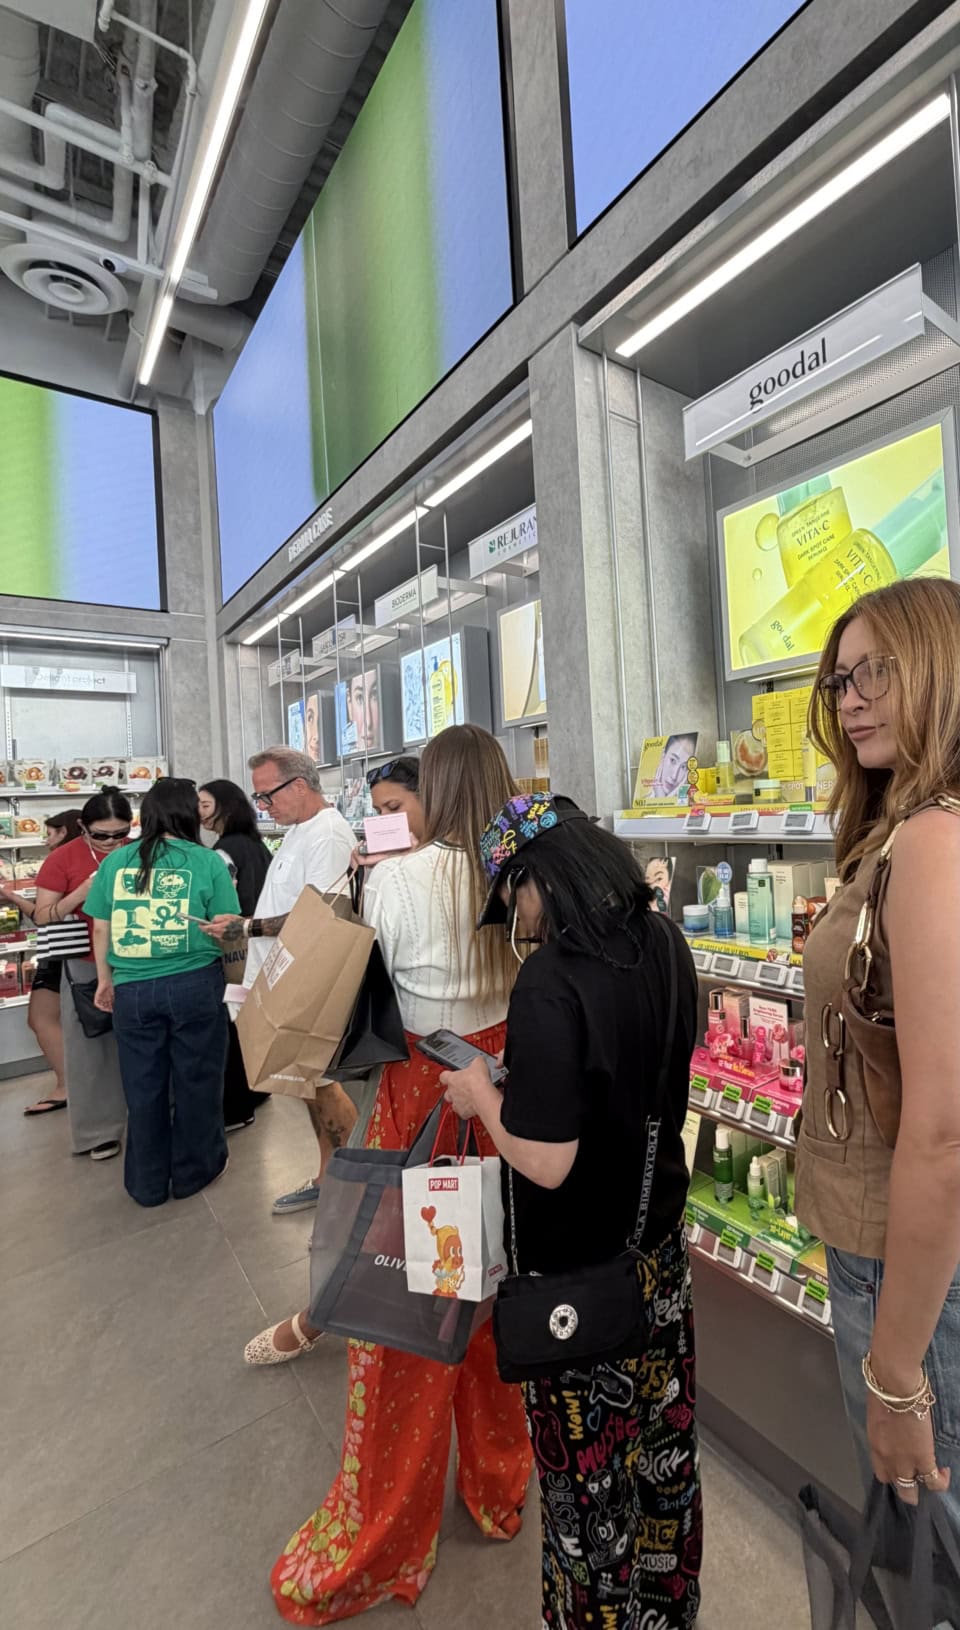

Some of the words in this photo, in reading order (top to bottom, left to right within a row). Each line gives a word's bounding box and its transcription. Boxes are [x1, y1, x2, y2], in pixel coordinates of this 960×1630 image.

[749, 337, 827, 412] goodal
[430, 1180, 441, 1190] POP
[442, 1179, 458, 1190] MART
[560, 1390, 584, 1440] WOW!
[577, 1411, 640, 1474] MUSIC
[598, 1519, 615, 1541] DJ
[639, 1553, 678, 1572] MUSIC
